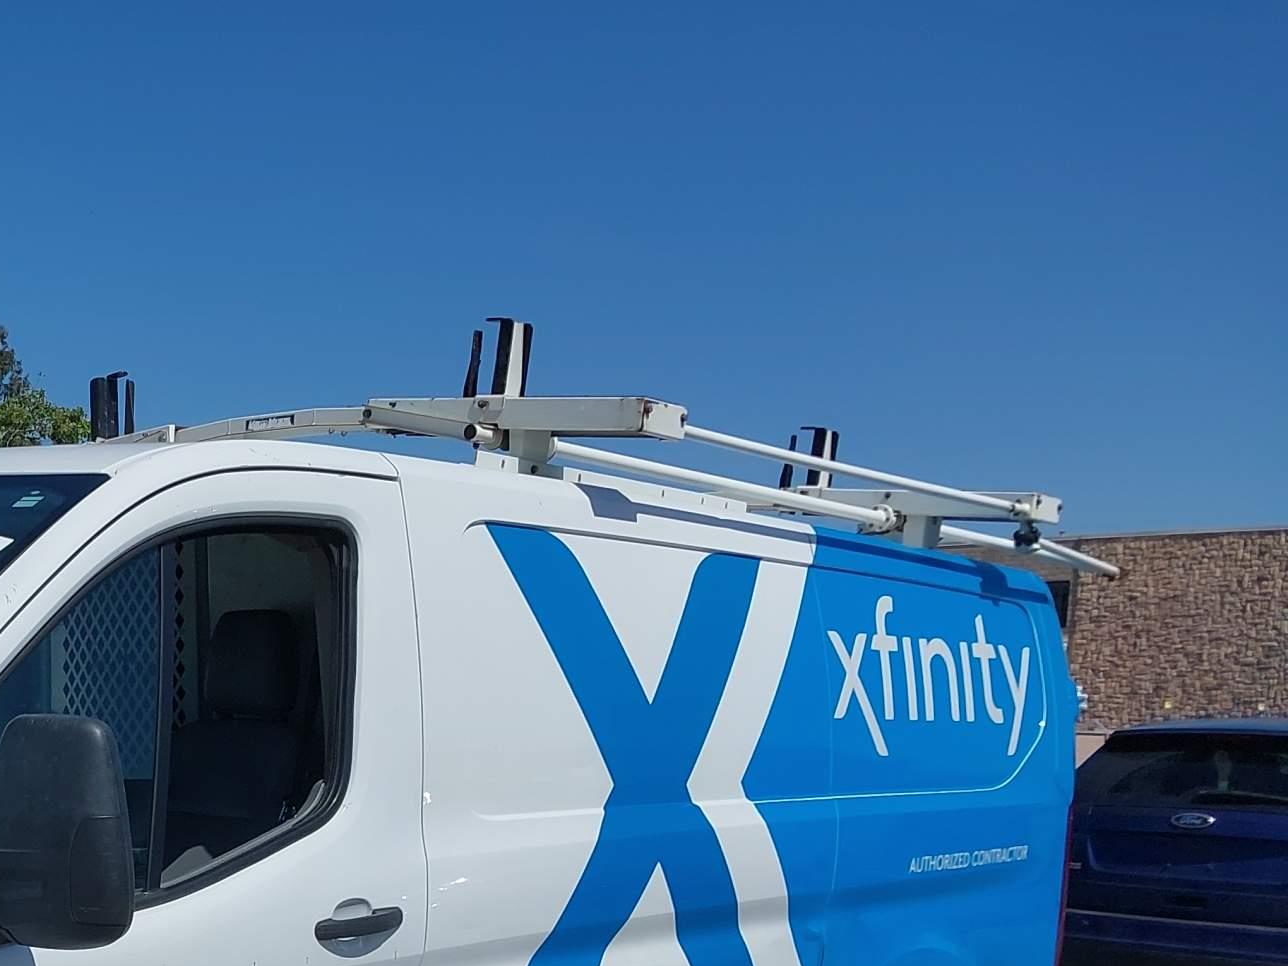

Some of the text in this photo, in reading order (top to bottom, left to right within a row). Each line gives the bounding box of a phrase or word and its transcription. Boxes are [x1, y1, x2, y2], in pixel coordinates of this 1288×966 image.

[826, 595, 1030, 757] xfinity
[909, 845, 1029, 873] AUTHORIZED CONTRACTOR
